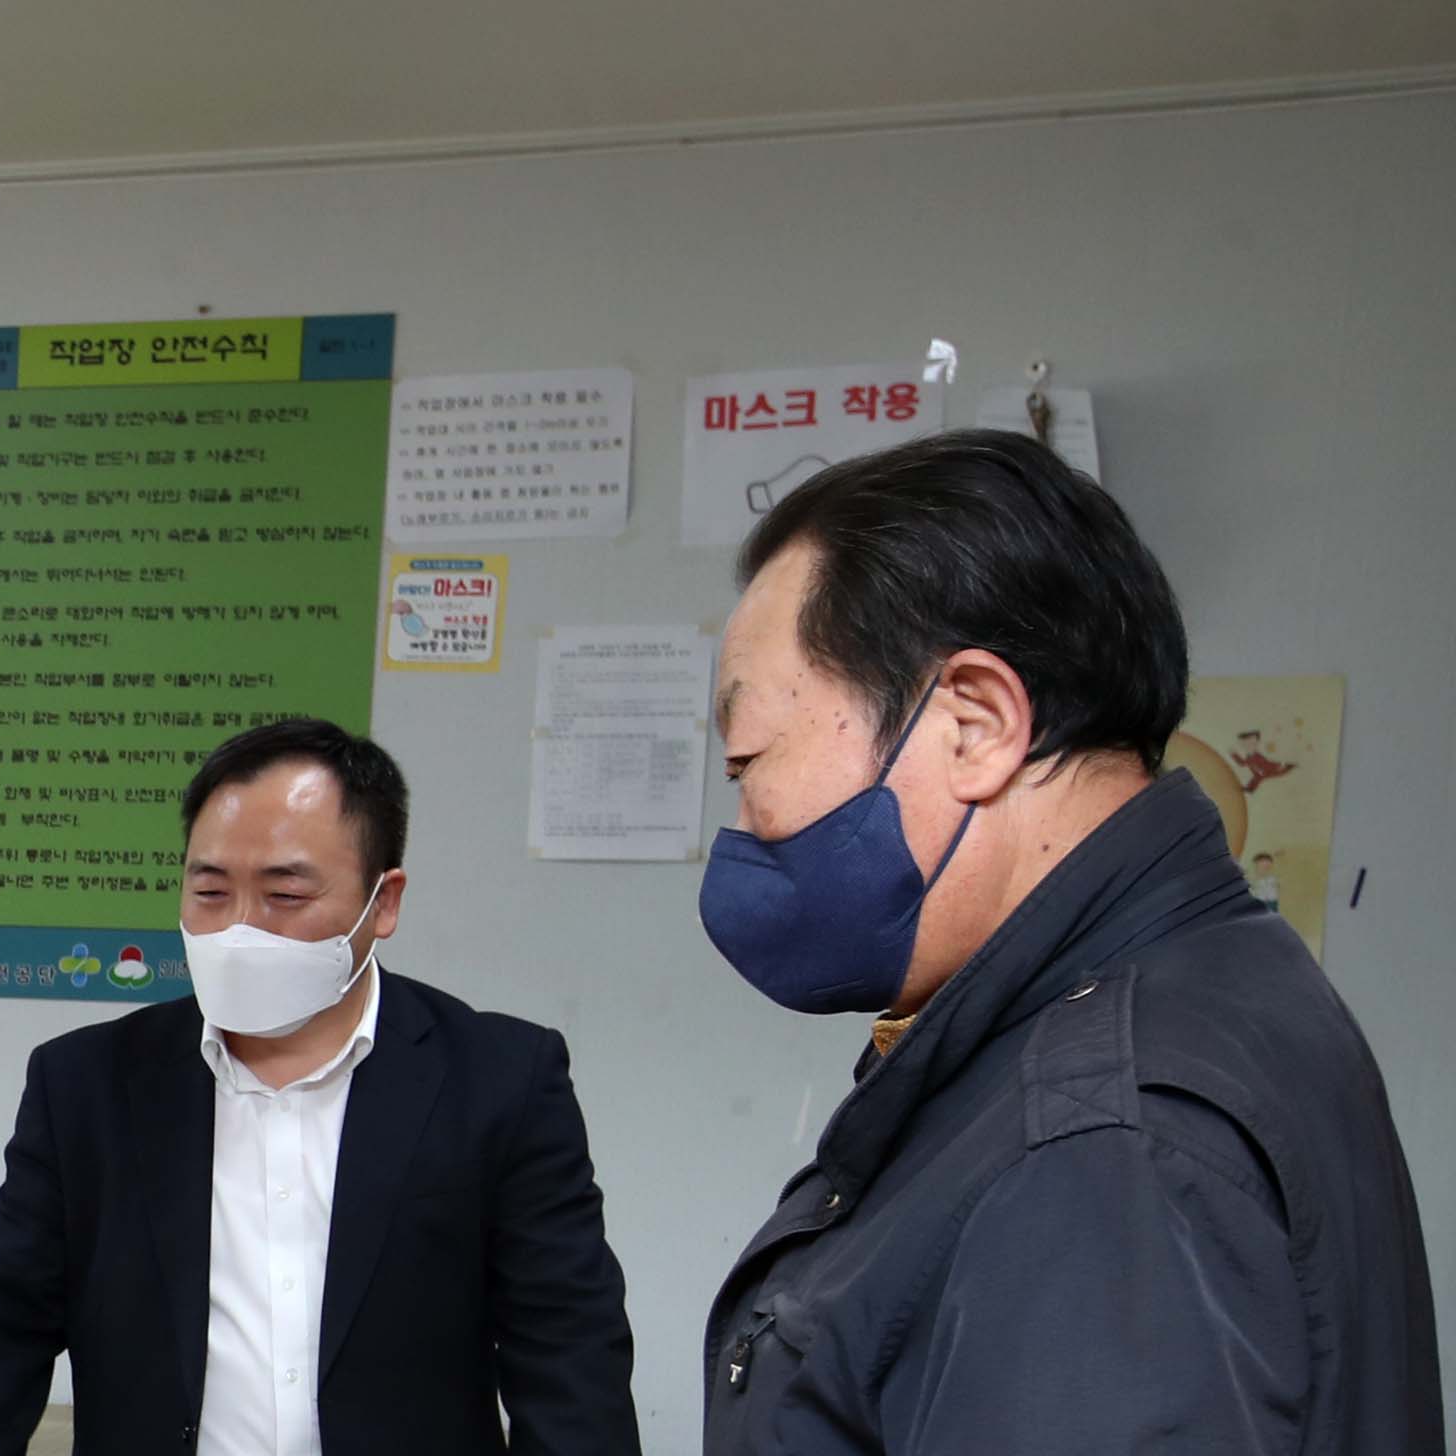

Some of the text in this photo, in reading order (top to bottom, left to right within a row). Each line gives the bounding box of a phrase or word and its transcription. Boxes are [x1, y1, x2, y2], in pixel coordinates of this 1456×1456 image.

[49, 333, 269, 366] 작업장 안전수칙
[704, 382, 920, 432] 마스크 착용
